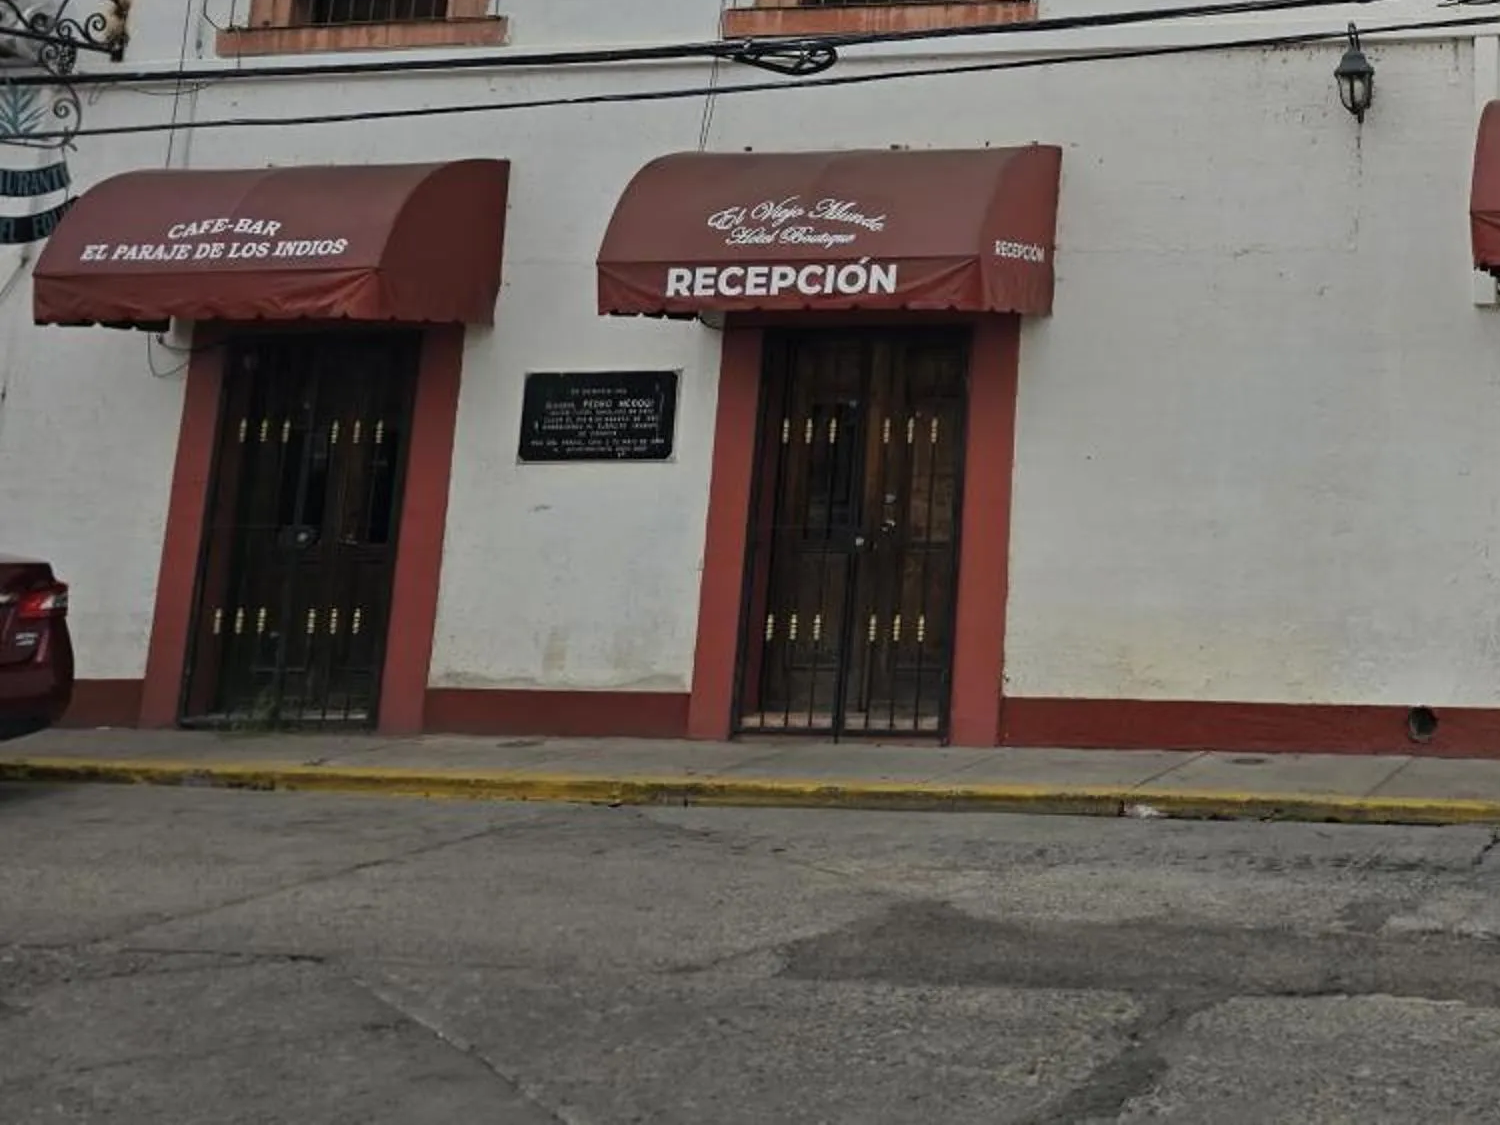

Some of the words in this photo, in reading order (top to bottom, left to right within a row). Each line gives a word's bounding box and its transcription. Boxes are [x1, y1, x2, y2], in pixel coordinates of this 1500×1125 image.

[80, 244, 109, 261] EL
[111, 243, 192, 261] PARAJE
[193, 242, 224, 259] DE
[228, 241, 270, 259] LOS
[272, 238, 349, 257] INDIOS
[664, 256, 898, 298] RECEPCIÓN
